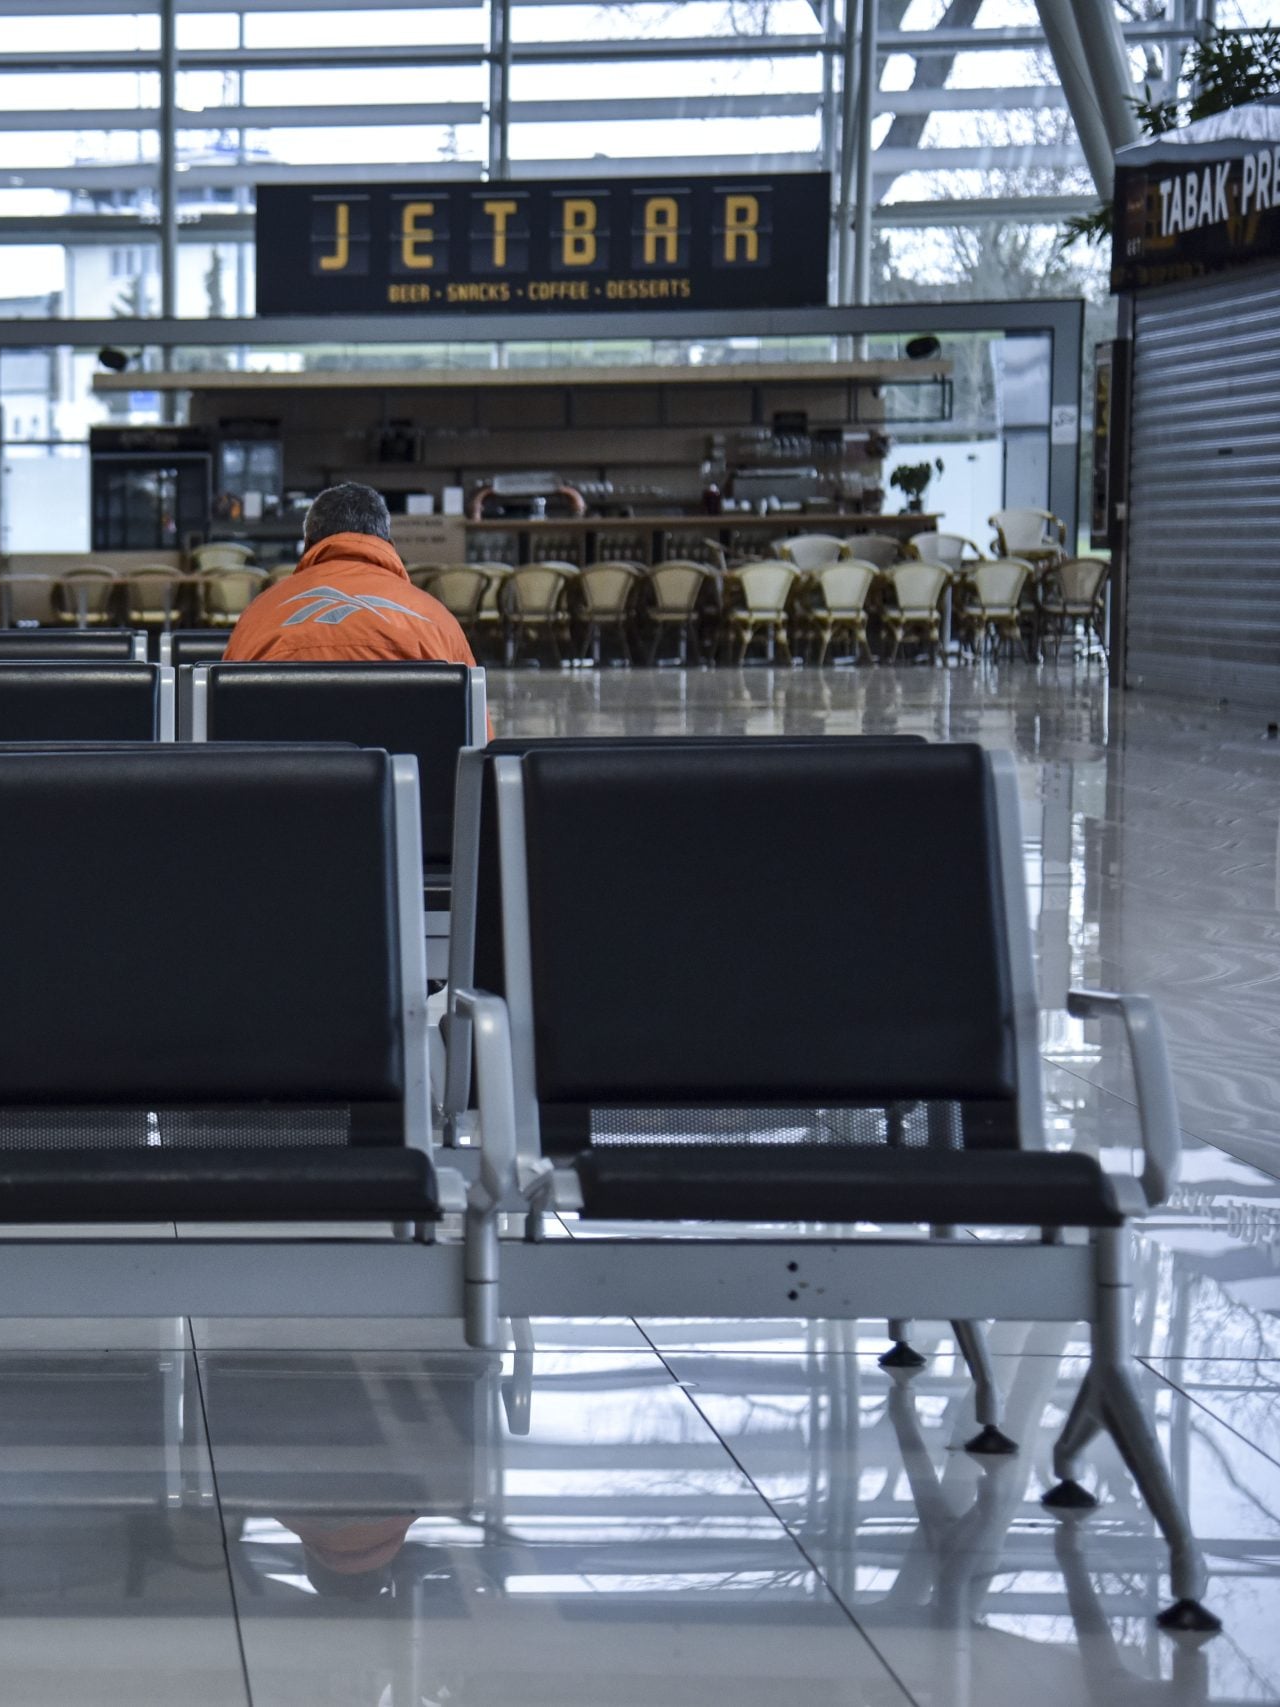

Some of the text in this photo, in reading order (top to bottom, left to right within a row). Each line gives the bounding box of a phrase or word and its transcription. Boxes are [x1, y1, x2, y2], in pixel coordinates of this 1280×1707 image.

[1159, 160, 1231, 237] TABAK
[388, 279, 691, 302] BEER SNACKS COFFEE DESSERTS
